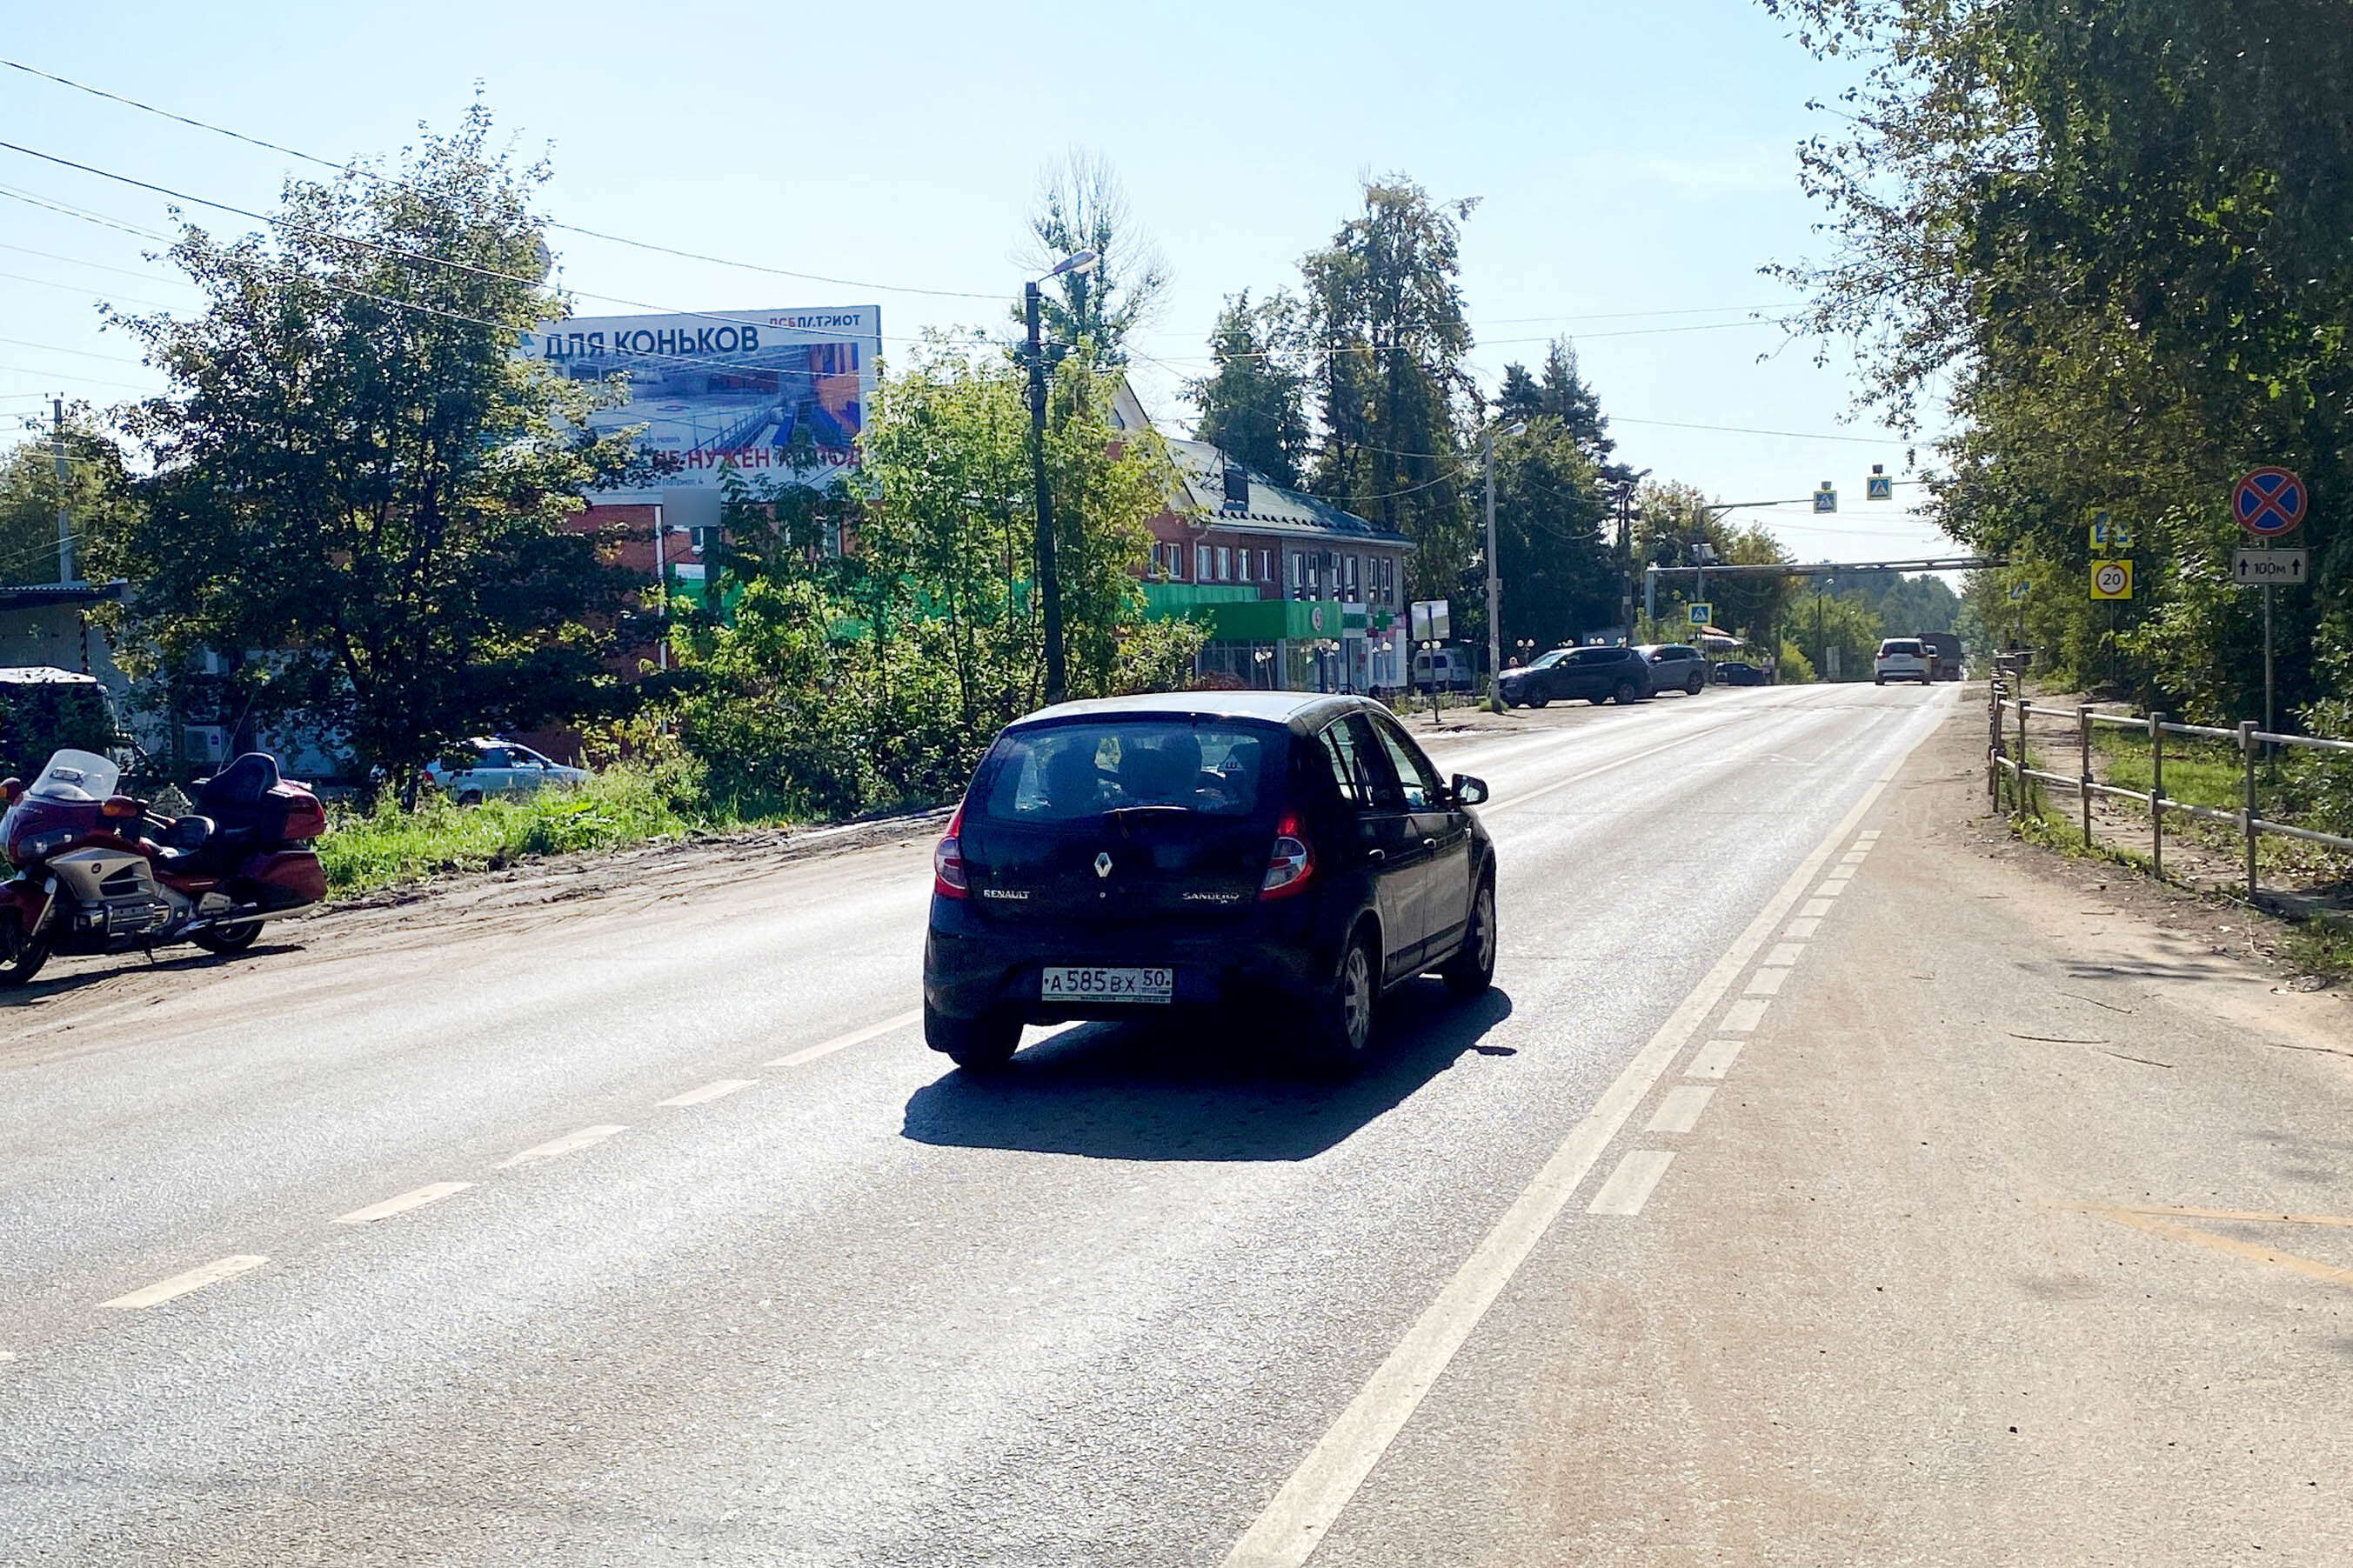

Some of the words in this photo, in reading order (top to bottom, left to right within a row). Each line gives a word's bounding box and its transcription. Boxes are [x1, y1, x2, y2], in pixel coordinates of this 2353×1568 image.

[544, 331, 605, 359] ДЛЯ
[614, 325, 759, 355] КОНЬКОВ
[687, 446, 771, 470] НУЖЕН
[2102, 573, 2121, 585] 20
[983, 889, 1031, 899] RENAULT
[1182, 891, 1240, 901] SANDERO
